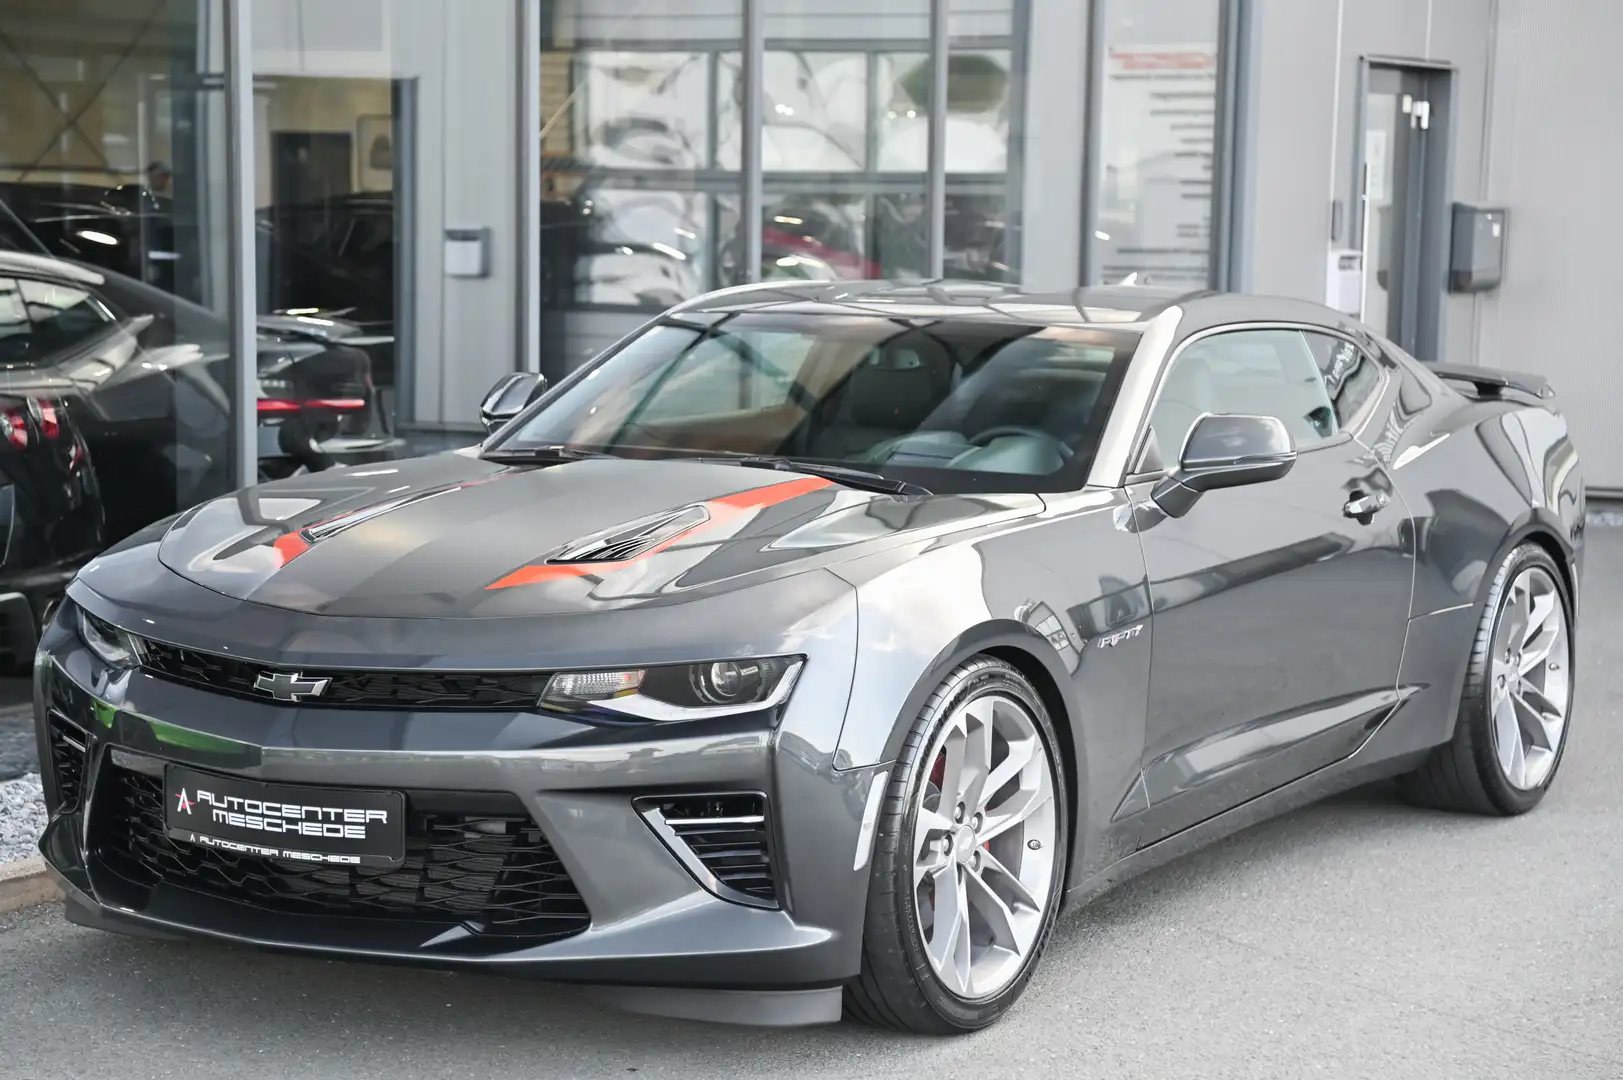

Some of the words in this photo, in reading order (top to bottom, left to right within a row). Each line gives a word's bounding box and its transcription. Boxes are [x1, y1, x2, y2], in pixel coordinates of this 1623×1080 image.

[196, 789, 388, 824] AUTOCENTER
[212, 808, 366, 839] MESCHEDE
[199, 835, 279, 857] AUTOCENTER
[282, 850, 361, 864] MESCHEDE
